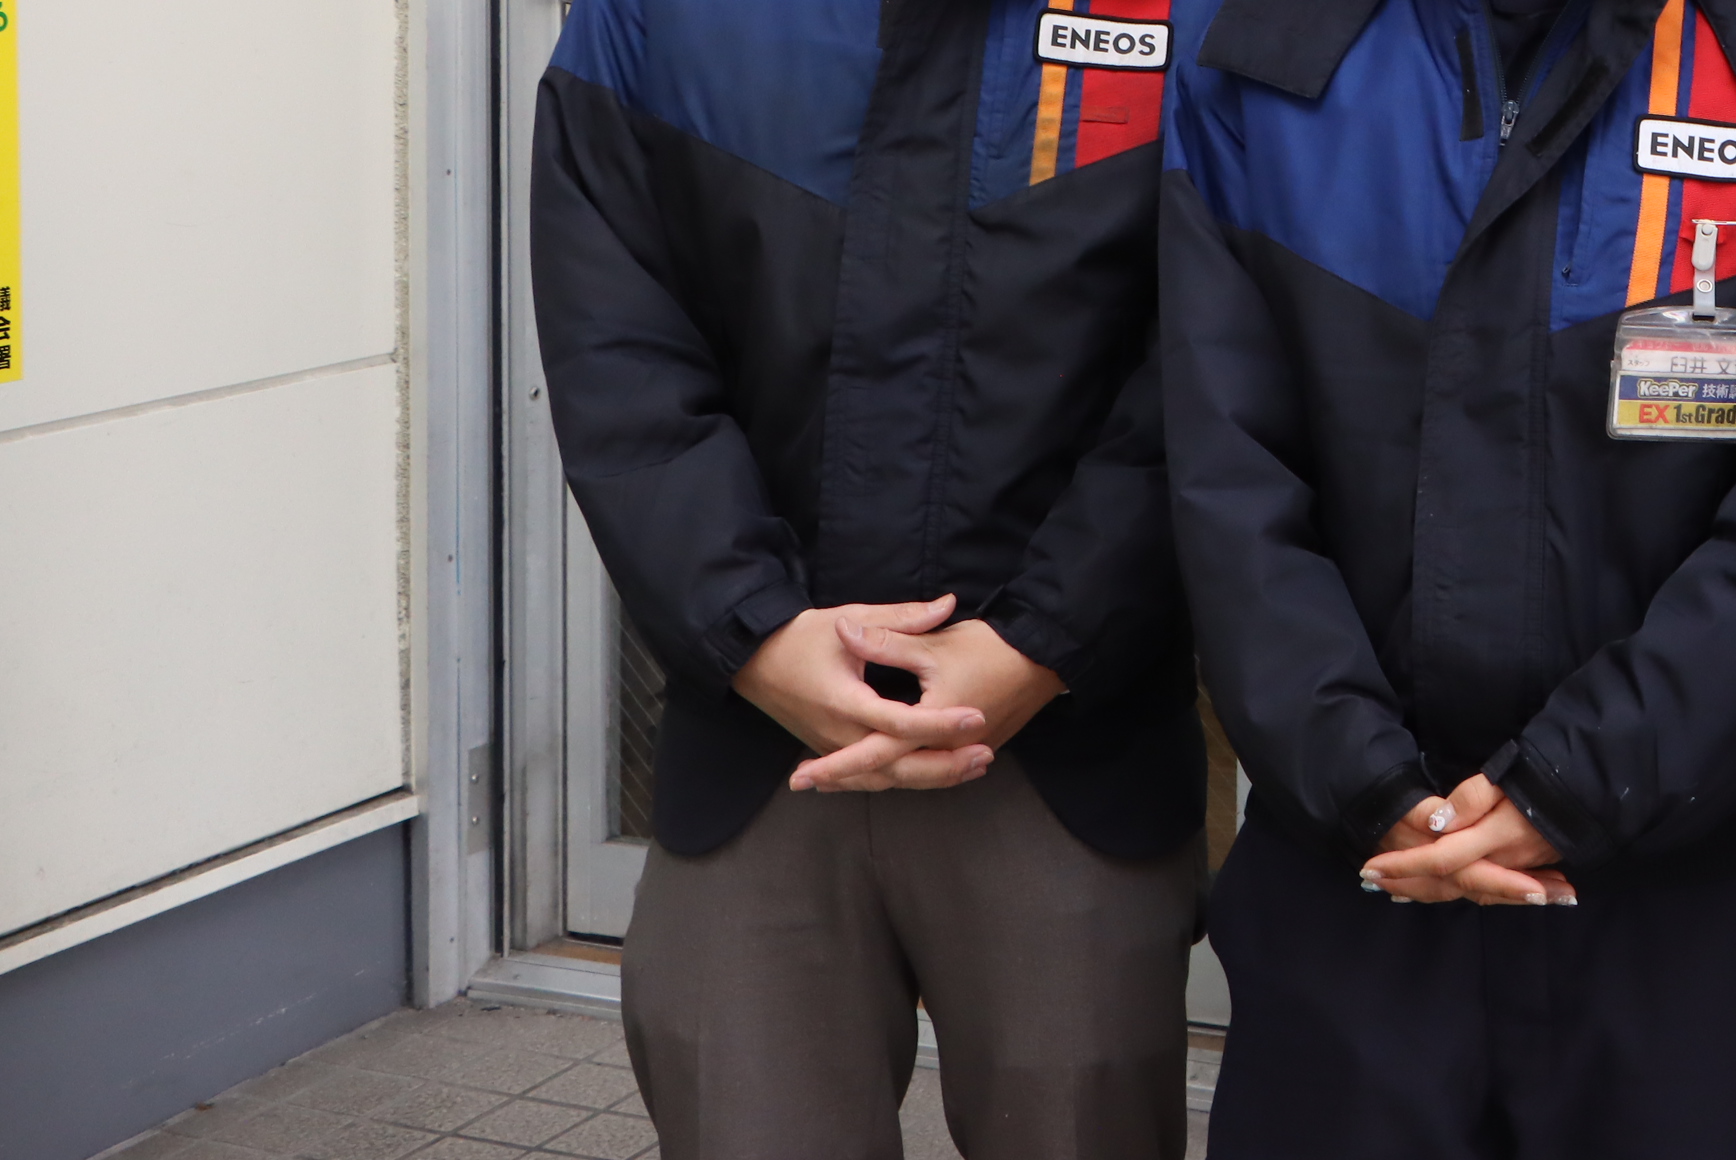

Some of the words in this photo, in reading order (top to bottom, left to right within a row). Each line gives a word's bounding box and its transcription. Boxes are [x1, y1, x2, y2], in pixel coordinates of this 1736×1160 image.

[1051, 24, 1156, 56] ENEOS
[1637, 379, 1698, 399] KeePer
[1639, 403, 1671, 424] EX
